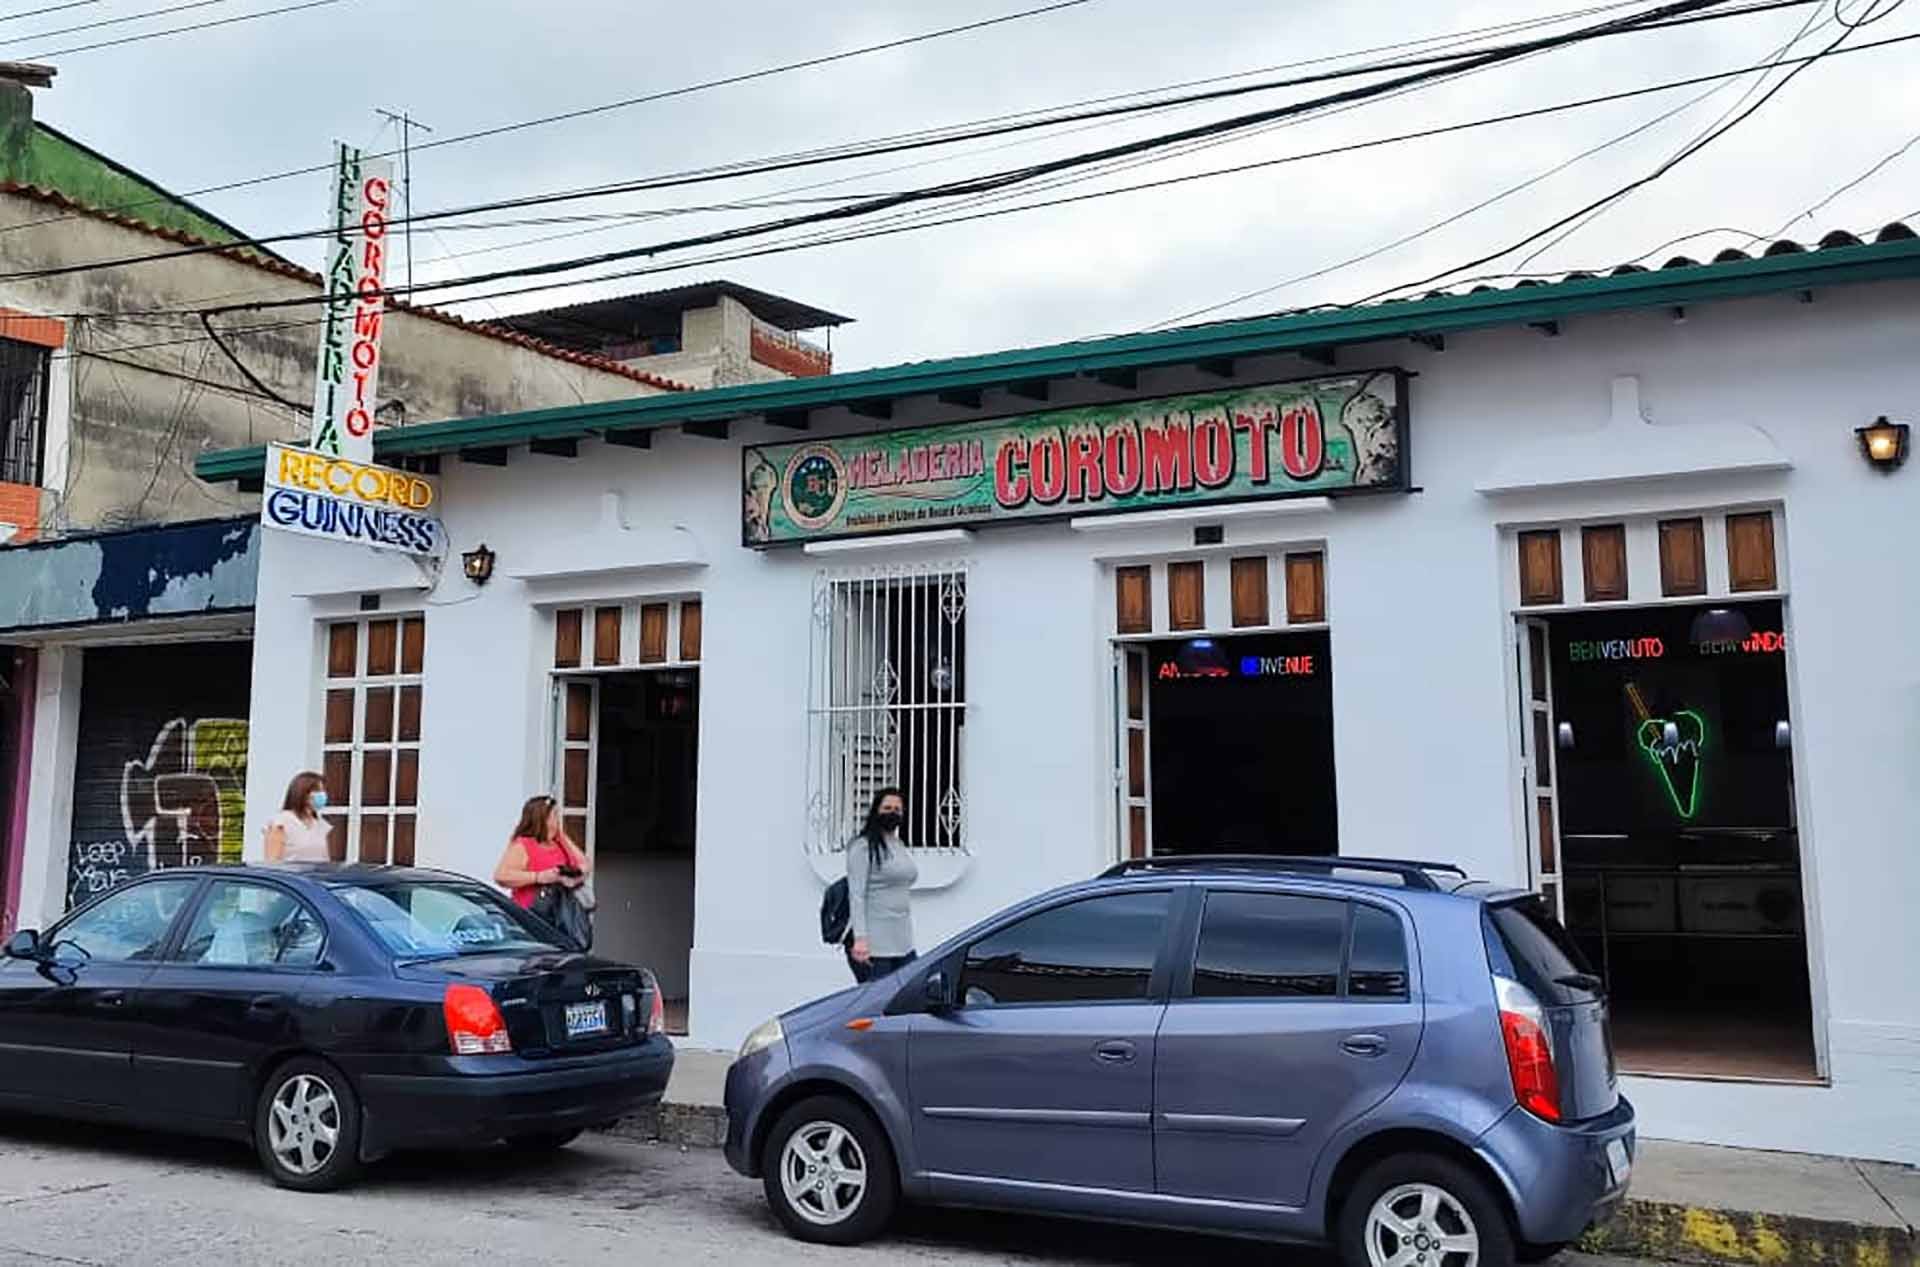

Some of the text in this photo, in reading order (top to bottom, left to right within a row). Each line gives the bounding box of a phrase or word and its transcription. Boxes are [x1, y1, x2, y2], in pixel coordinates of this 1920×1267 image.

[315, 143, 360, 454] HELADERIA
[347, 178, 386, 436] COROMOTO
[279, 449, 432, 510] RECORD
[847, 438, 985, 489] HELADERIA
[995, 399, 1325, 507] COROMOTO
[268, 490, 433, 552] GUINNESS
[1569, 637, 1664, 661] BENVENUTO
